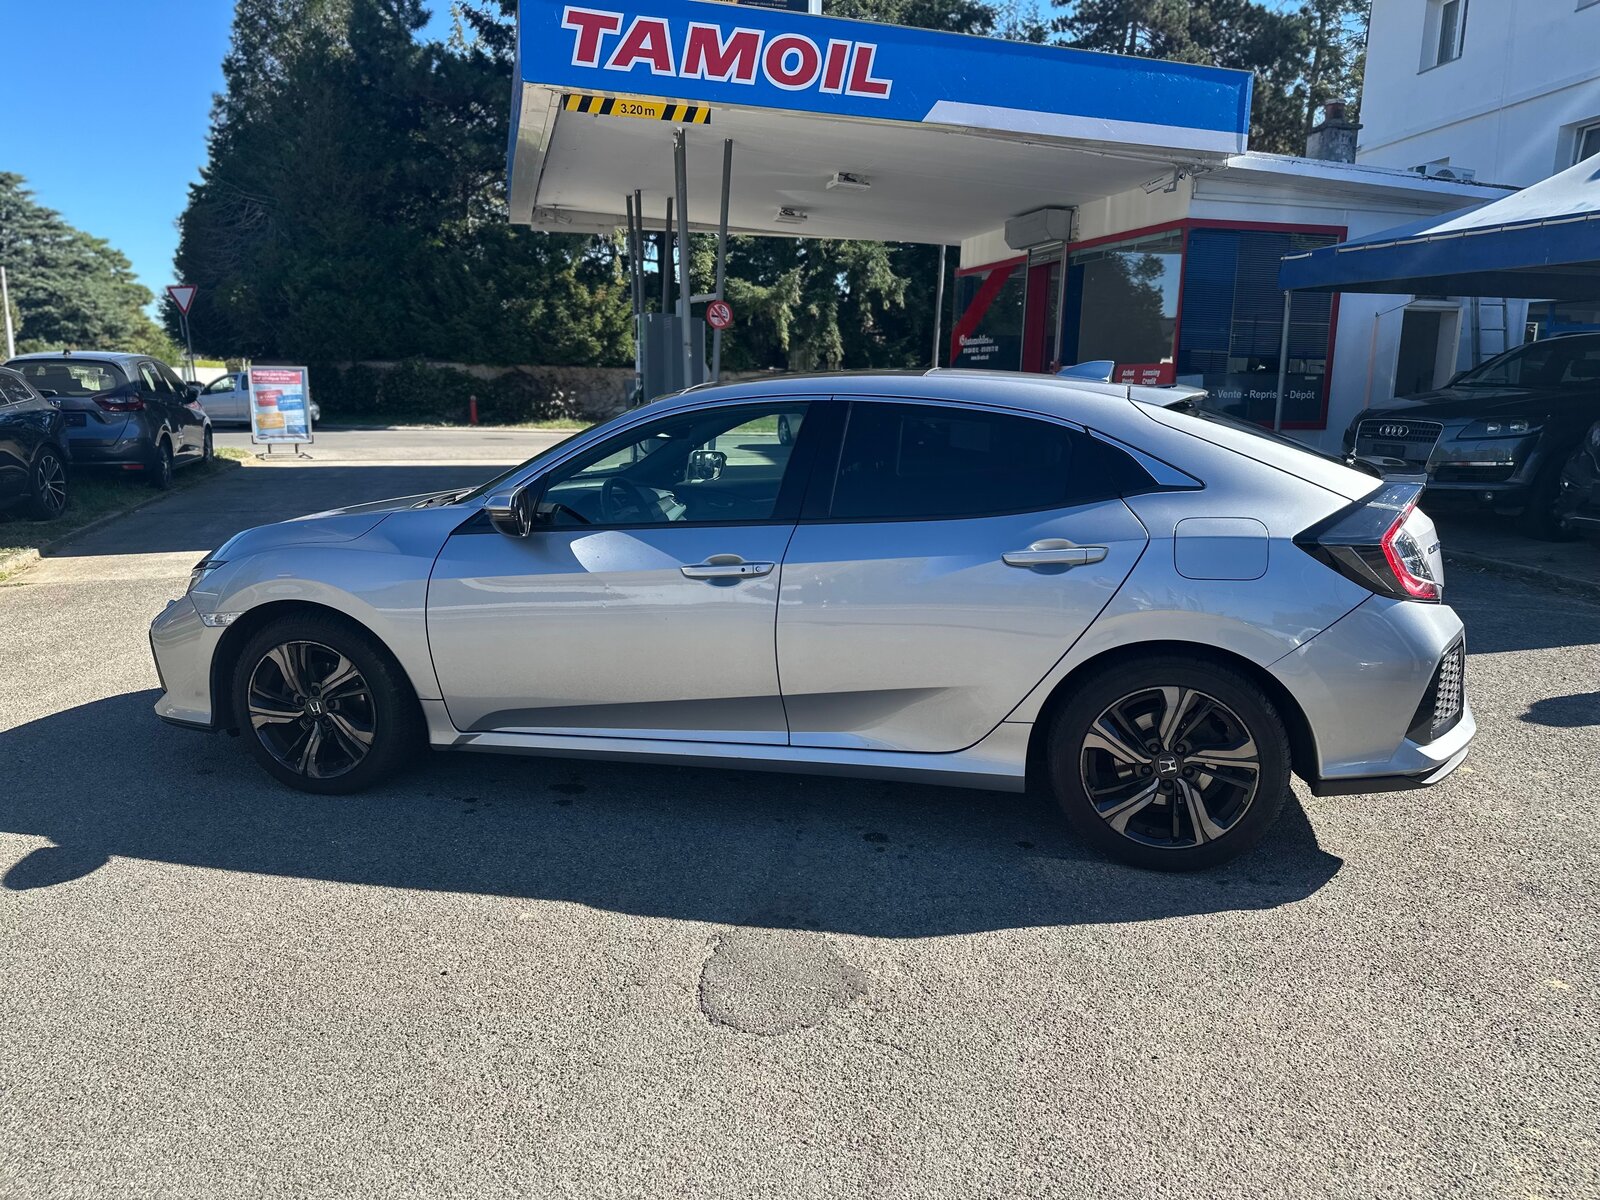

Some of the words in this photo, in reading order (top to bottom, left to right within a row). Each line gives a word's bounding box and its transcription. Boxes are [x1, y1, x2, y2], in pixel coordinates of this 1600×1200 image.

[562, 6, 892, 99] TAMOIL
[620, 103, 643, 115] 3.20
[645, 107, 655, 116] m
[1122, 369, 1135, 377] Achat
[1142, 369, 1161, 378] Leasing
[1217, 390, 1242, 399] Vente
[1249, 390, 1280, 400] Repris
[1290, 390, 1315, 400] Dépôt
